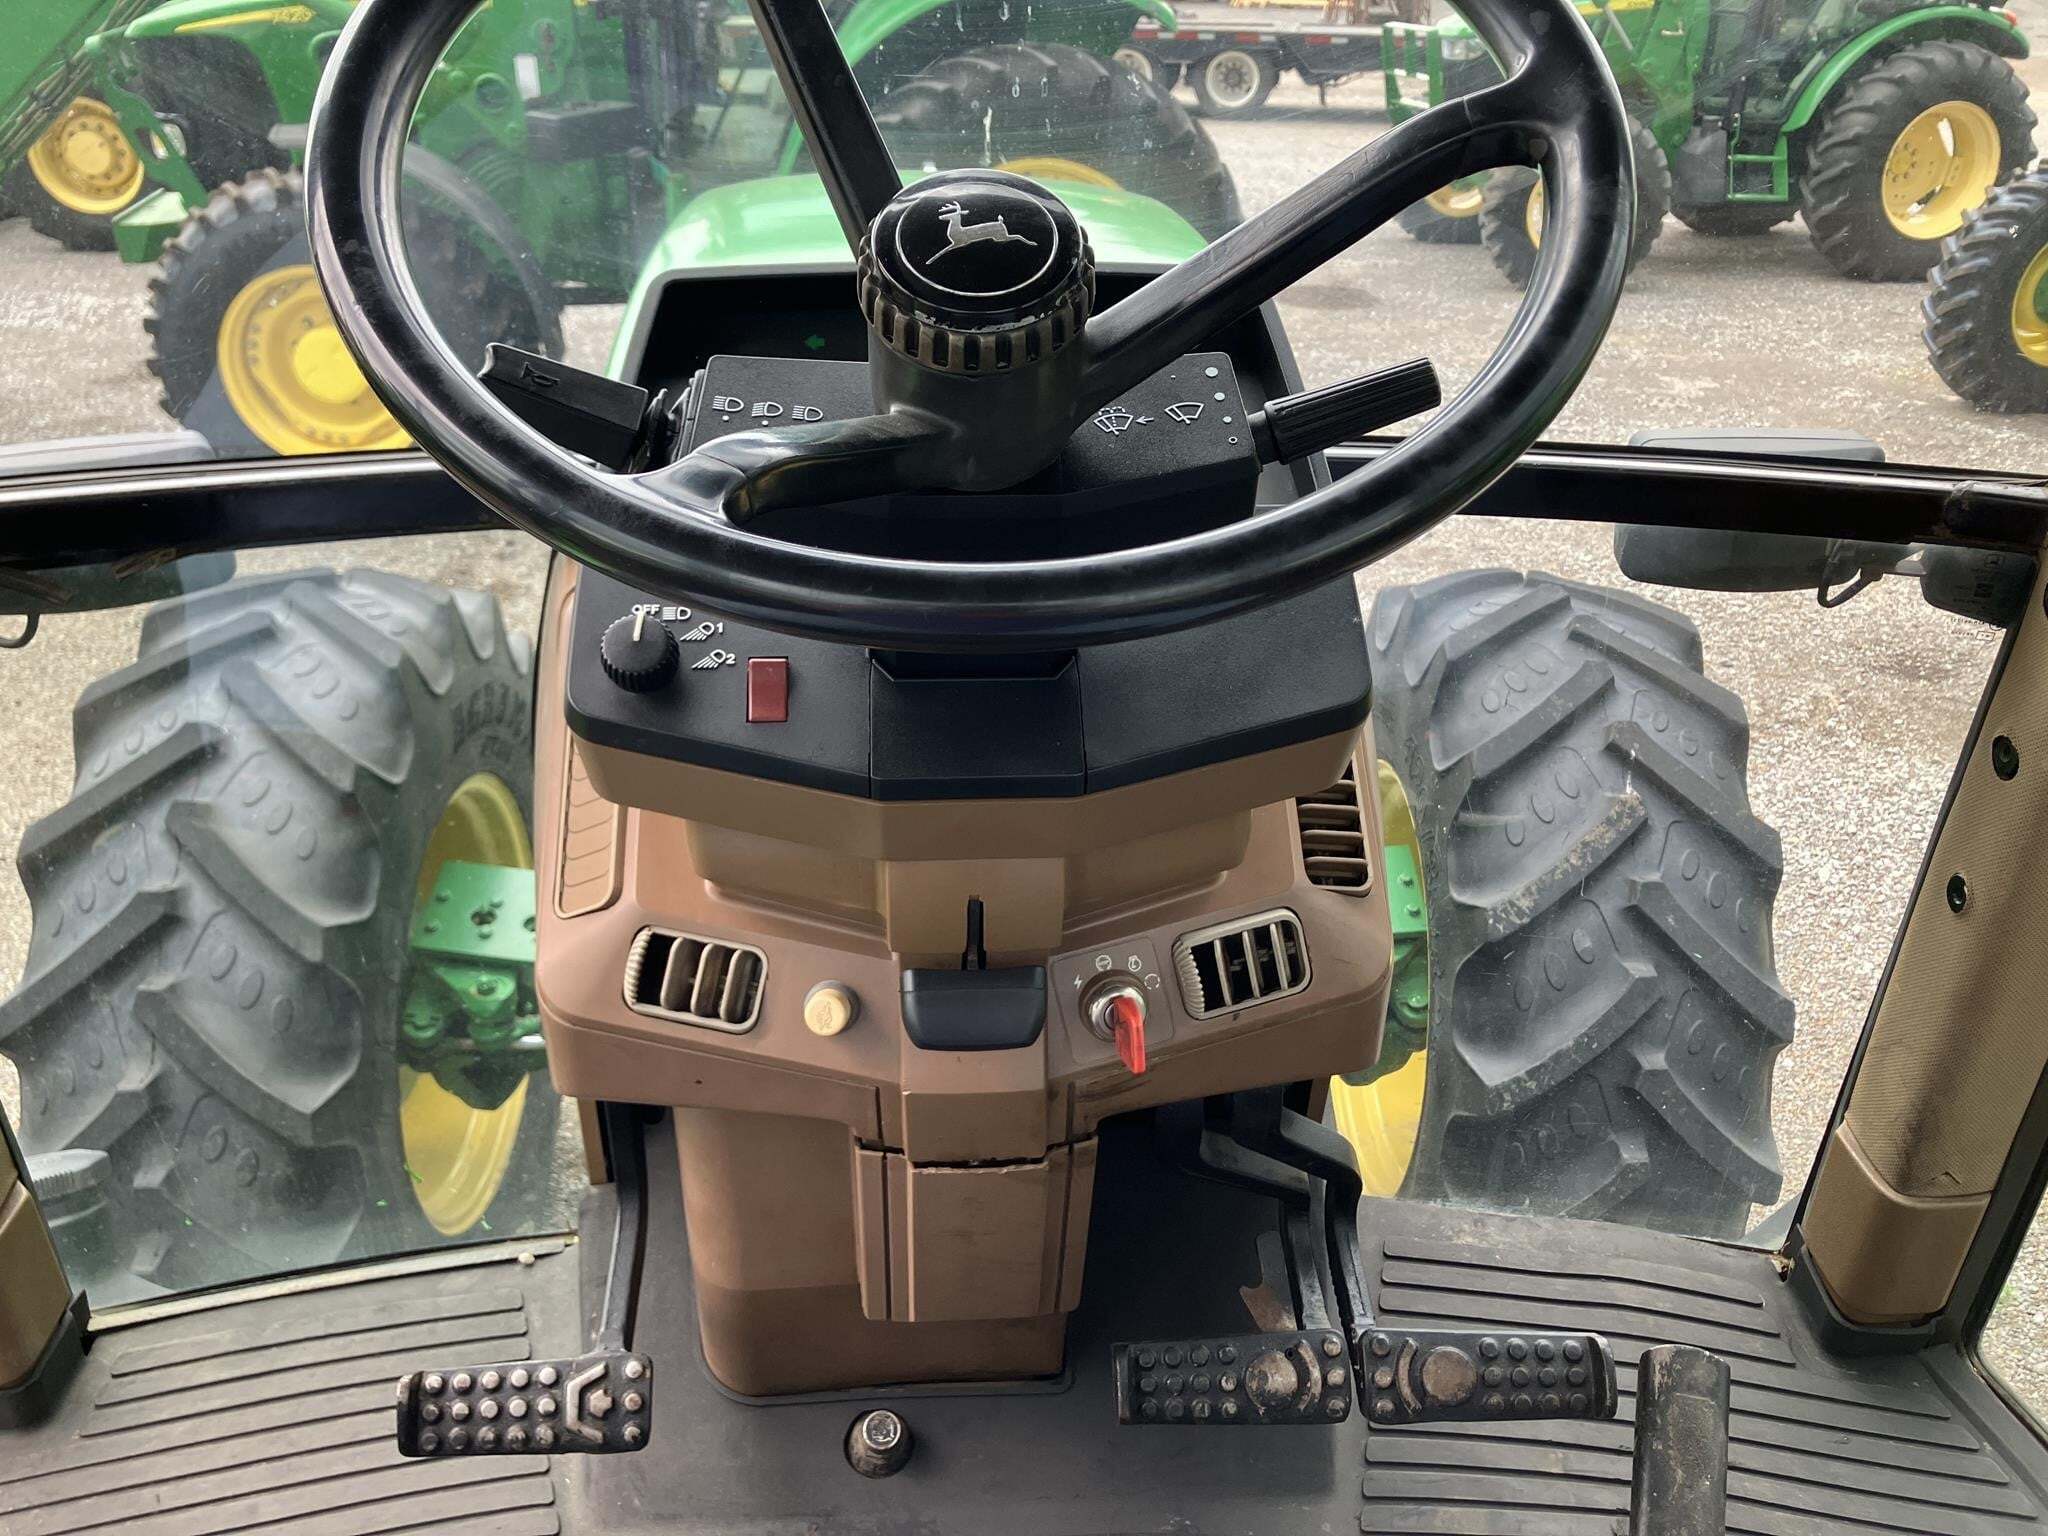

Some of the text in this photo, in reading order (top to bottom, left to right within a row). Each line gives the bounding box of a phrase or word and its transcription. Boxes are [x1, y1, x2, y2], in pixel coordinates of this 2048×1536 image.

[631, 604, 660, 615] OFF
[716, 622, 724, 633] 1
[725, 653, 736, 665] 2
